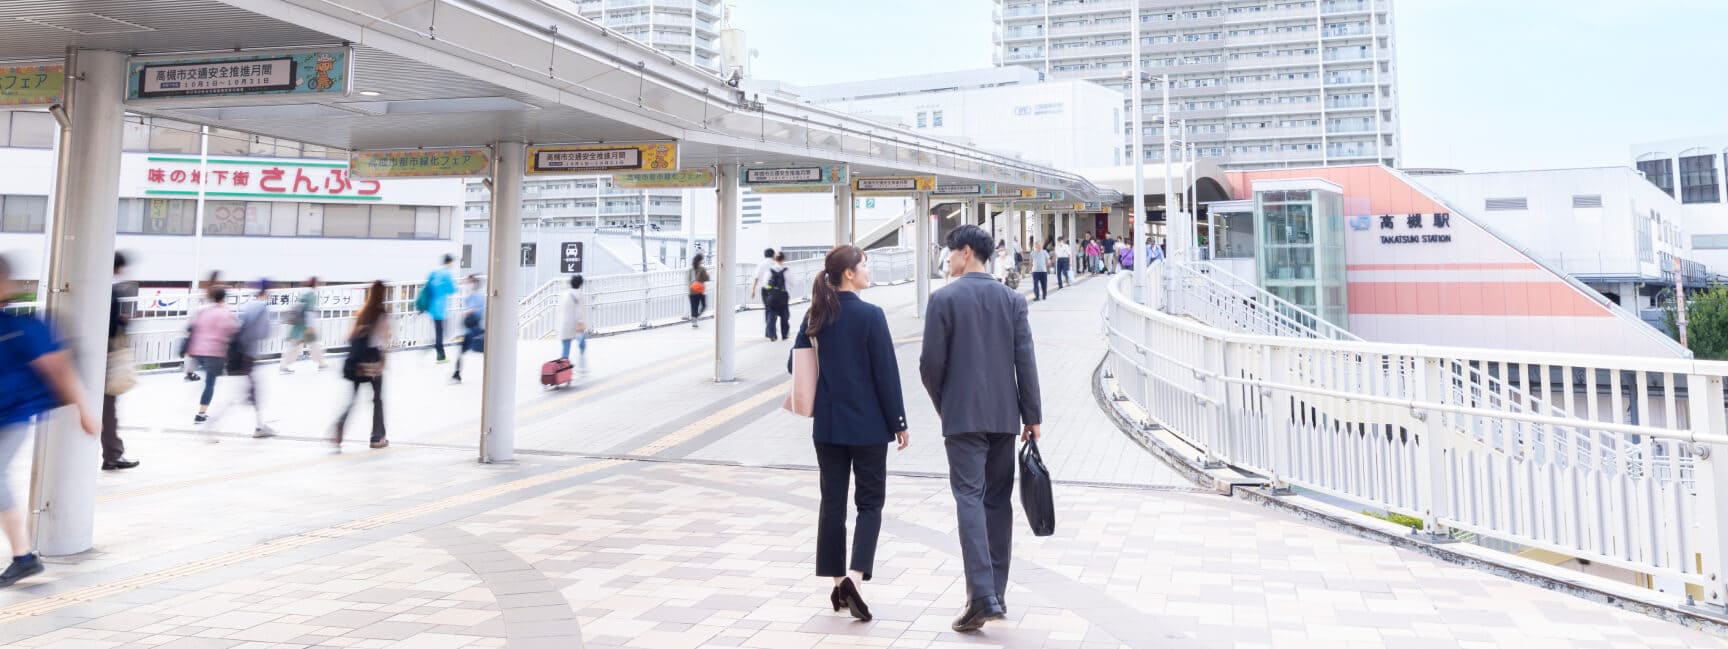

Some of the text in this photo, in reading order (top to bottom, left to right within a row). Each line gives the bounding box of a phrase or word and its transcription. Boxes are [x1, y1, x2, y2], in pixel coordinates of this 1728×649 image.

[156, 64, 272, 81] 高槻市交通安全推進月間
[0, 74, 47, 89] フェア
[148, 168, 250, 186] 味の地下街
[1380, 213, 1450, 229] 高槻駅
[1380, 234, 1451, 244] TAKATSUKI STATION
